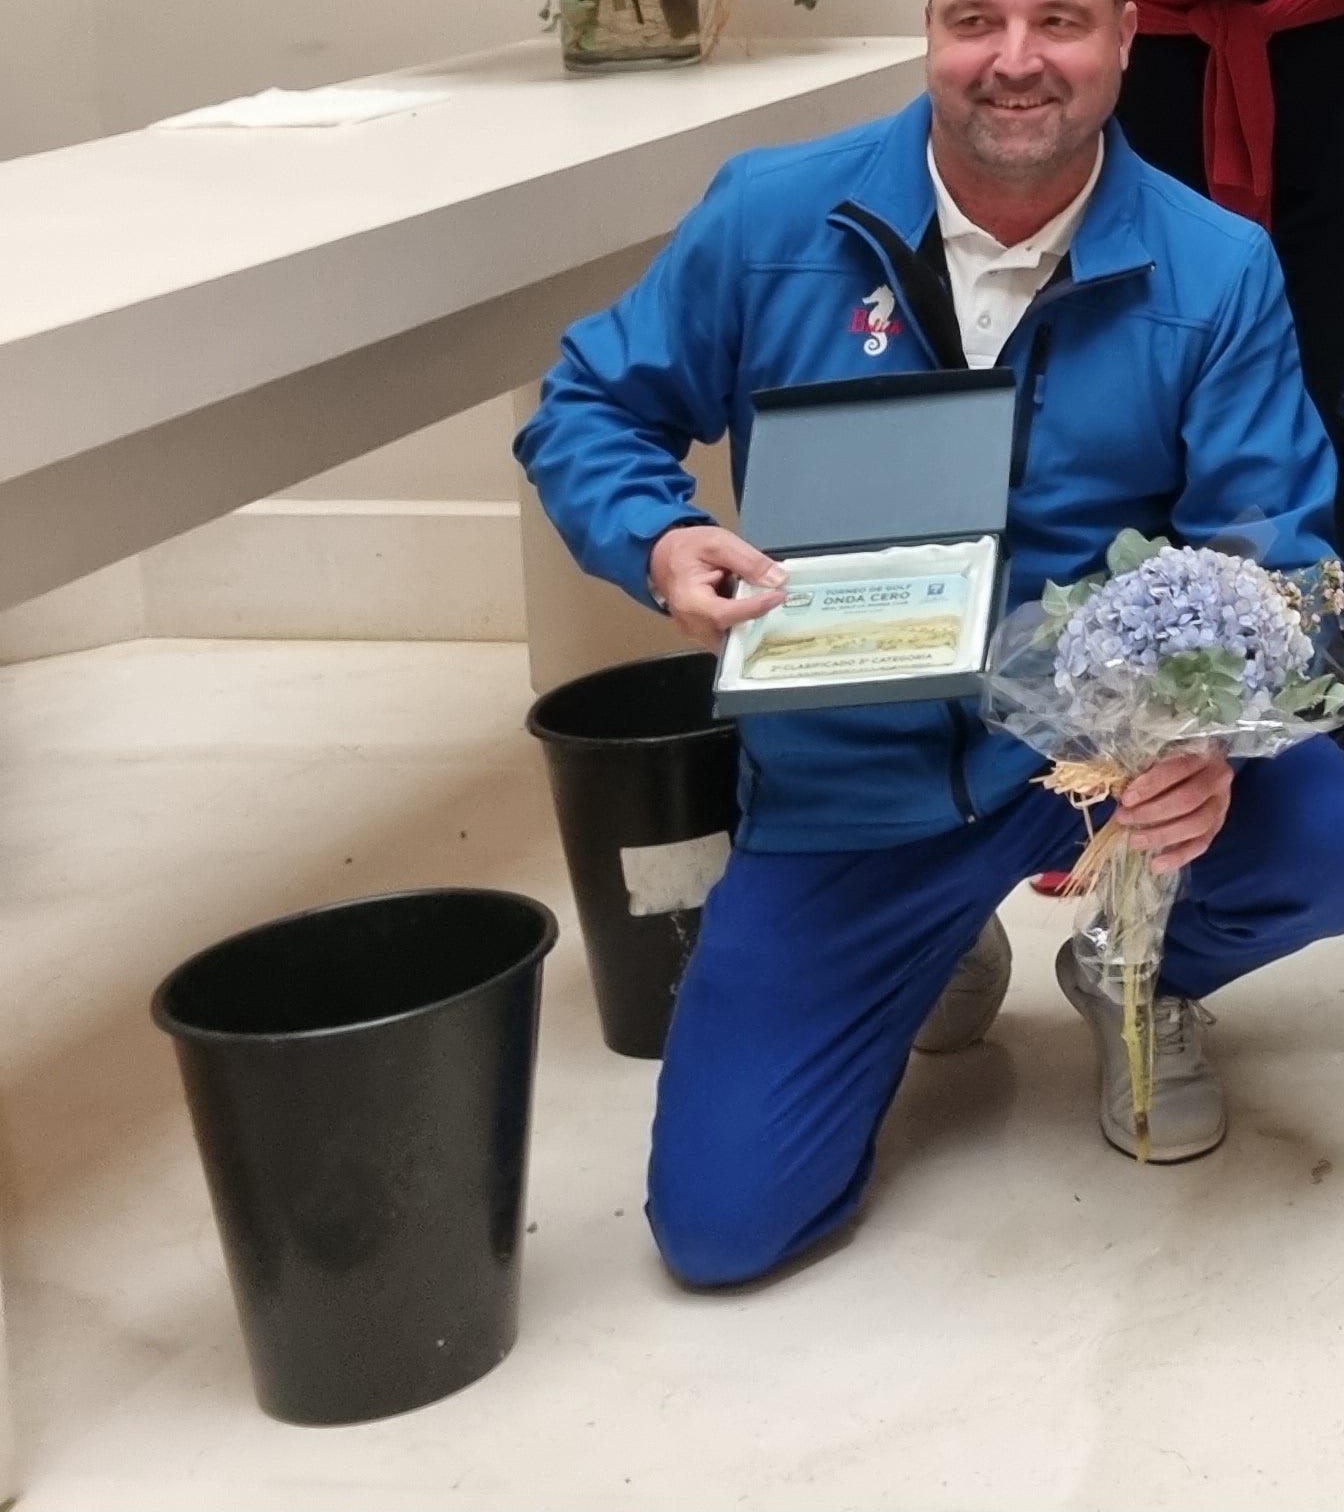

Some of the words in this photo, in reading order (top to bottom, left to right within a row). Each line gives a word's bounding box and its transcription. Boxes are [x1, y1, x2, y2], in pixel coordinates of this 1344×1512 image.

[823, 593, 866, 606] ONDA
[869, 590, 911, 602] CERO
[783, 658, 856, 672] CLASIFICADO
